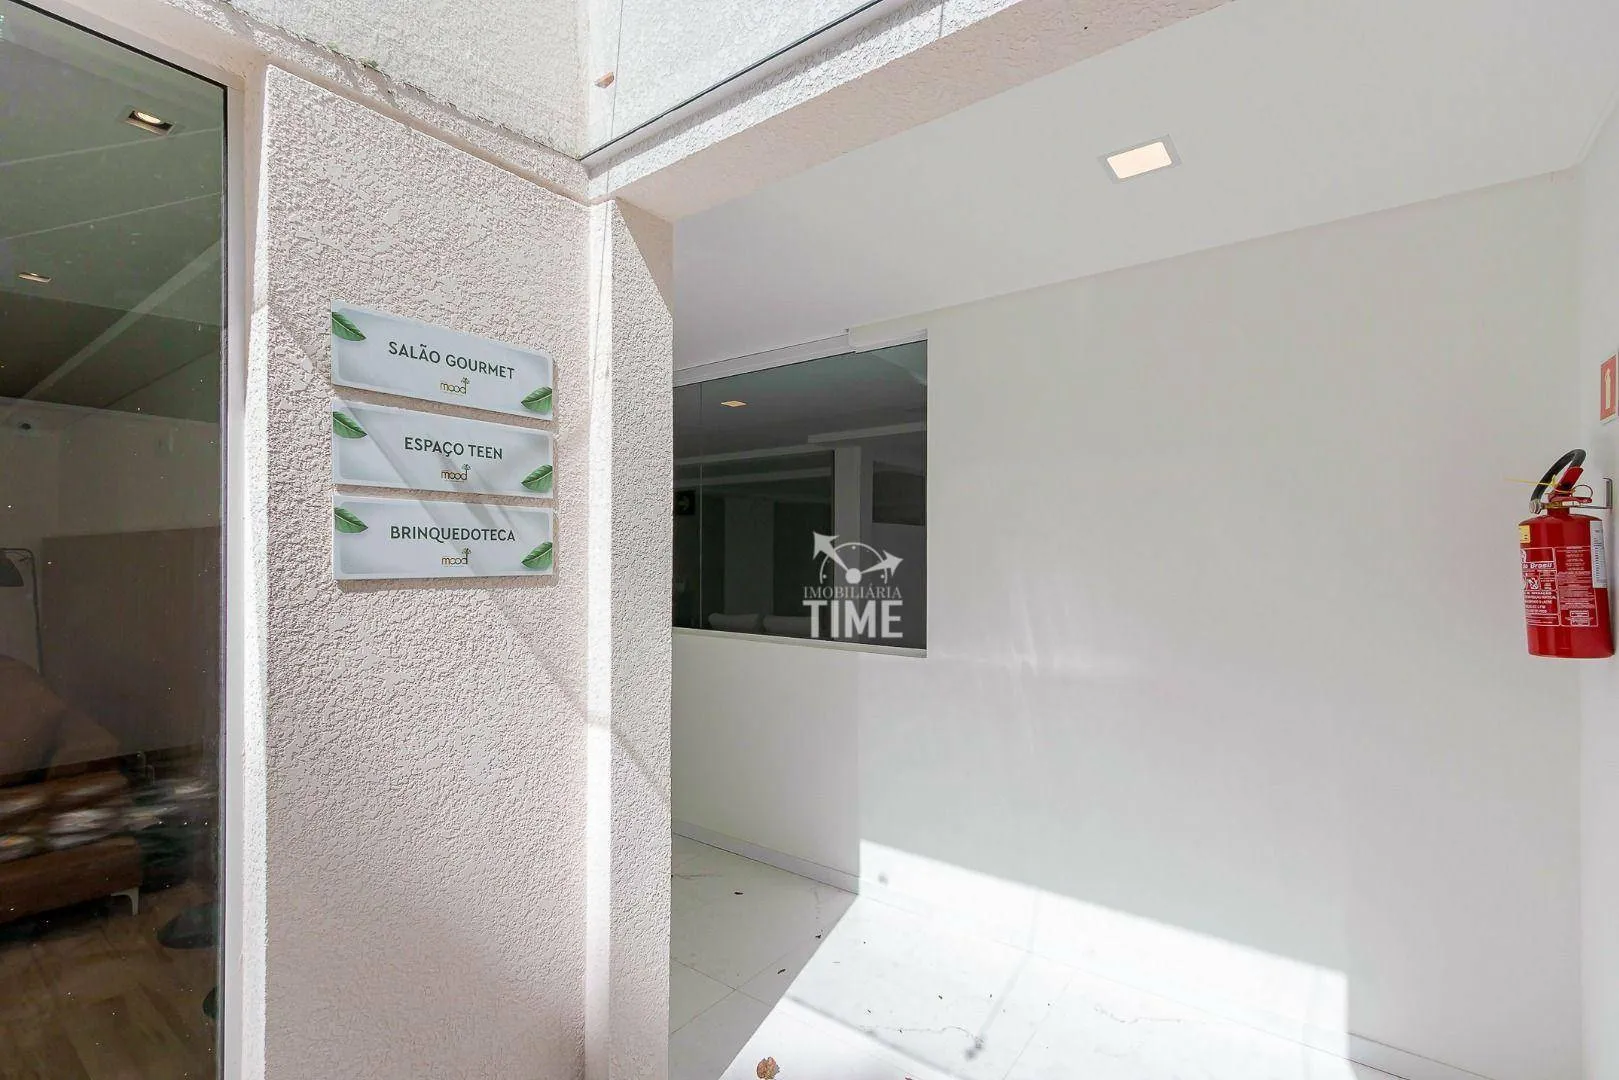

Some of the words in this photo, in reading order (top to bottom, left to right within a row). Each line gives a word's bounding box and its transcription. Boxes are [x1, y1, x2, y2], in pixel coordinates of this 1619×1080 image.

[388, 341, 441, 364] SALÃO
[445, 354, 515, 379] GOURMET
[440, 378, 468, 394] mood
[404, 436, 464, 457] ESPAÇO
[468, 444, 503, 460] TEEN
[441, 464, 470, 480] mood
[390, 525, 516, 543] BRINQUEDOTECA
[441, 548, 470, 565] mood
